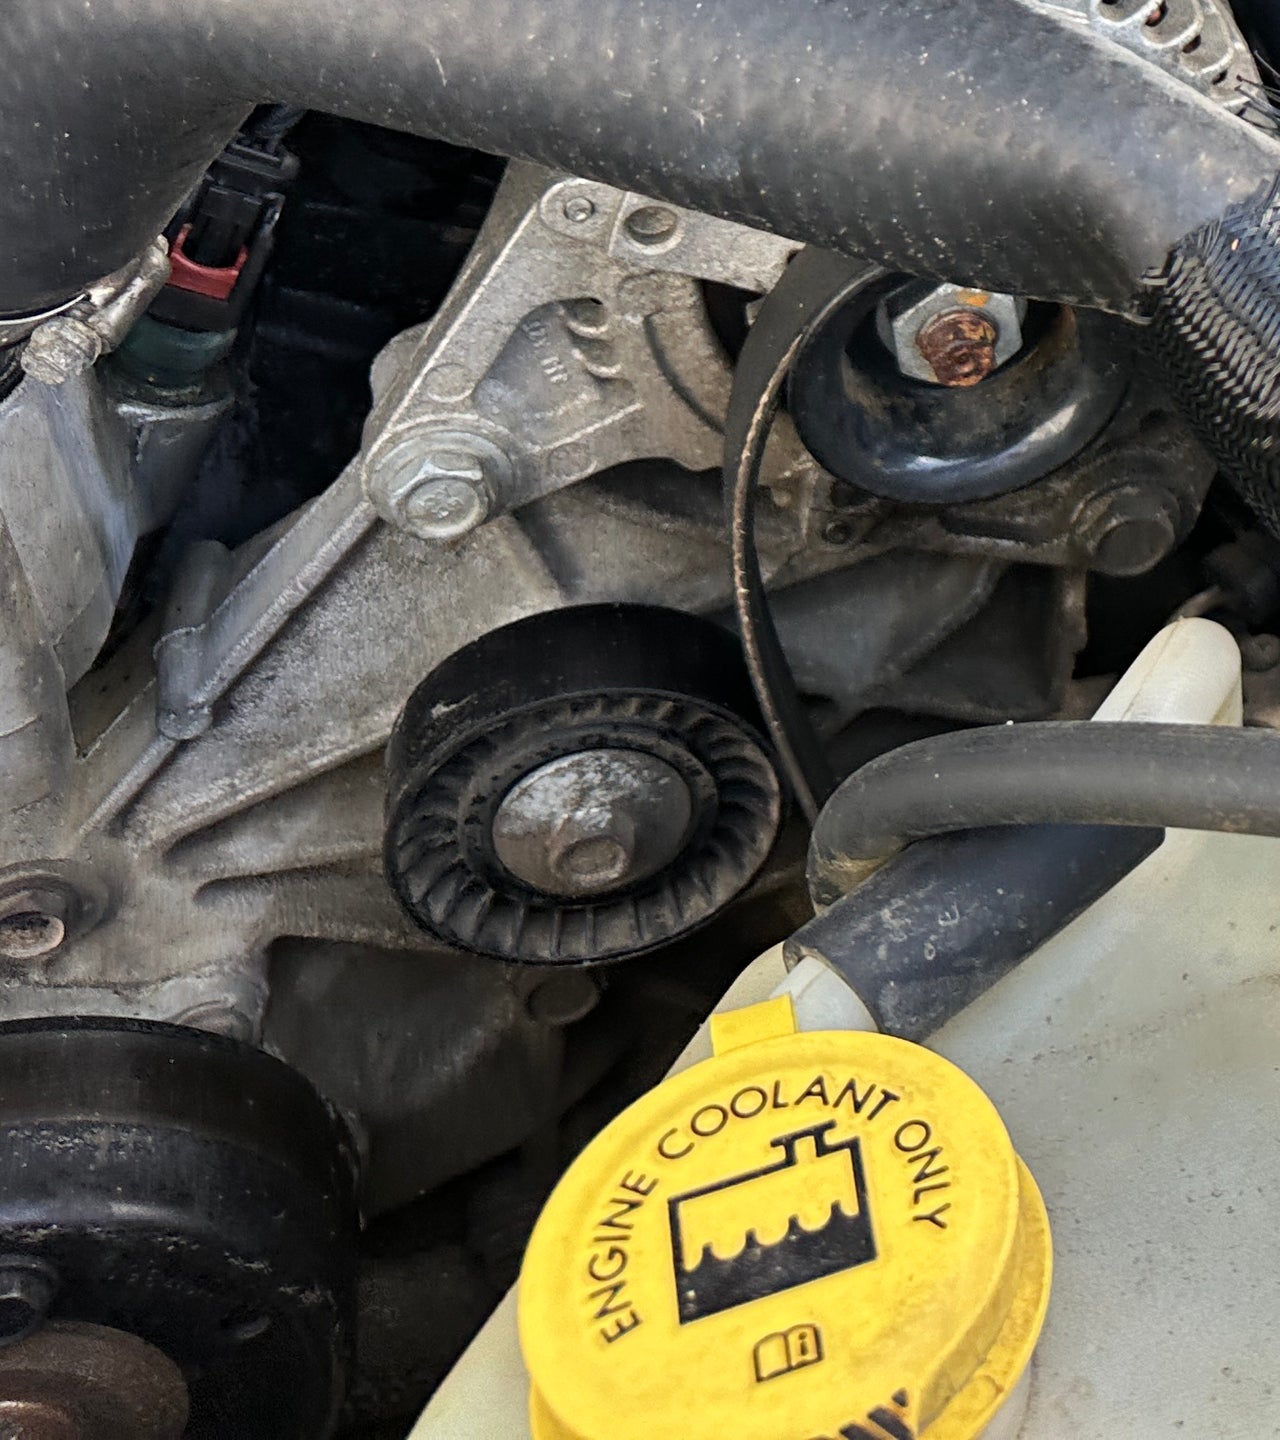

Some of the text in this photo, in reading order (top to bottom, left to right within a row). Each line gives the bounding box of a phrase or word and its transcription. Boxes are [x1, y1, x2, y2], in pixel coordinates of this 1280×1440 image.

[588, 1074, 952, 1344] ENGINE COOLANT ONLY
